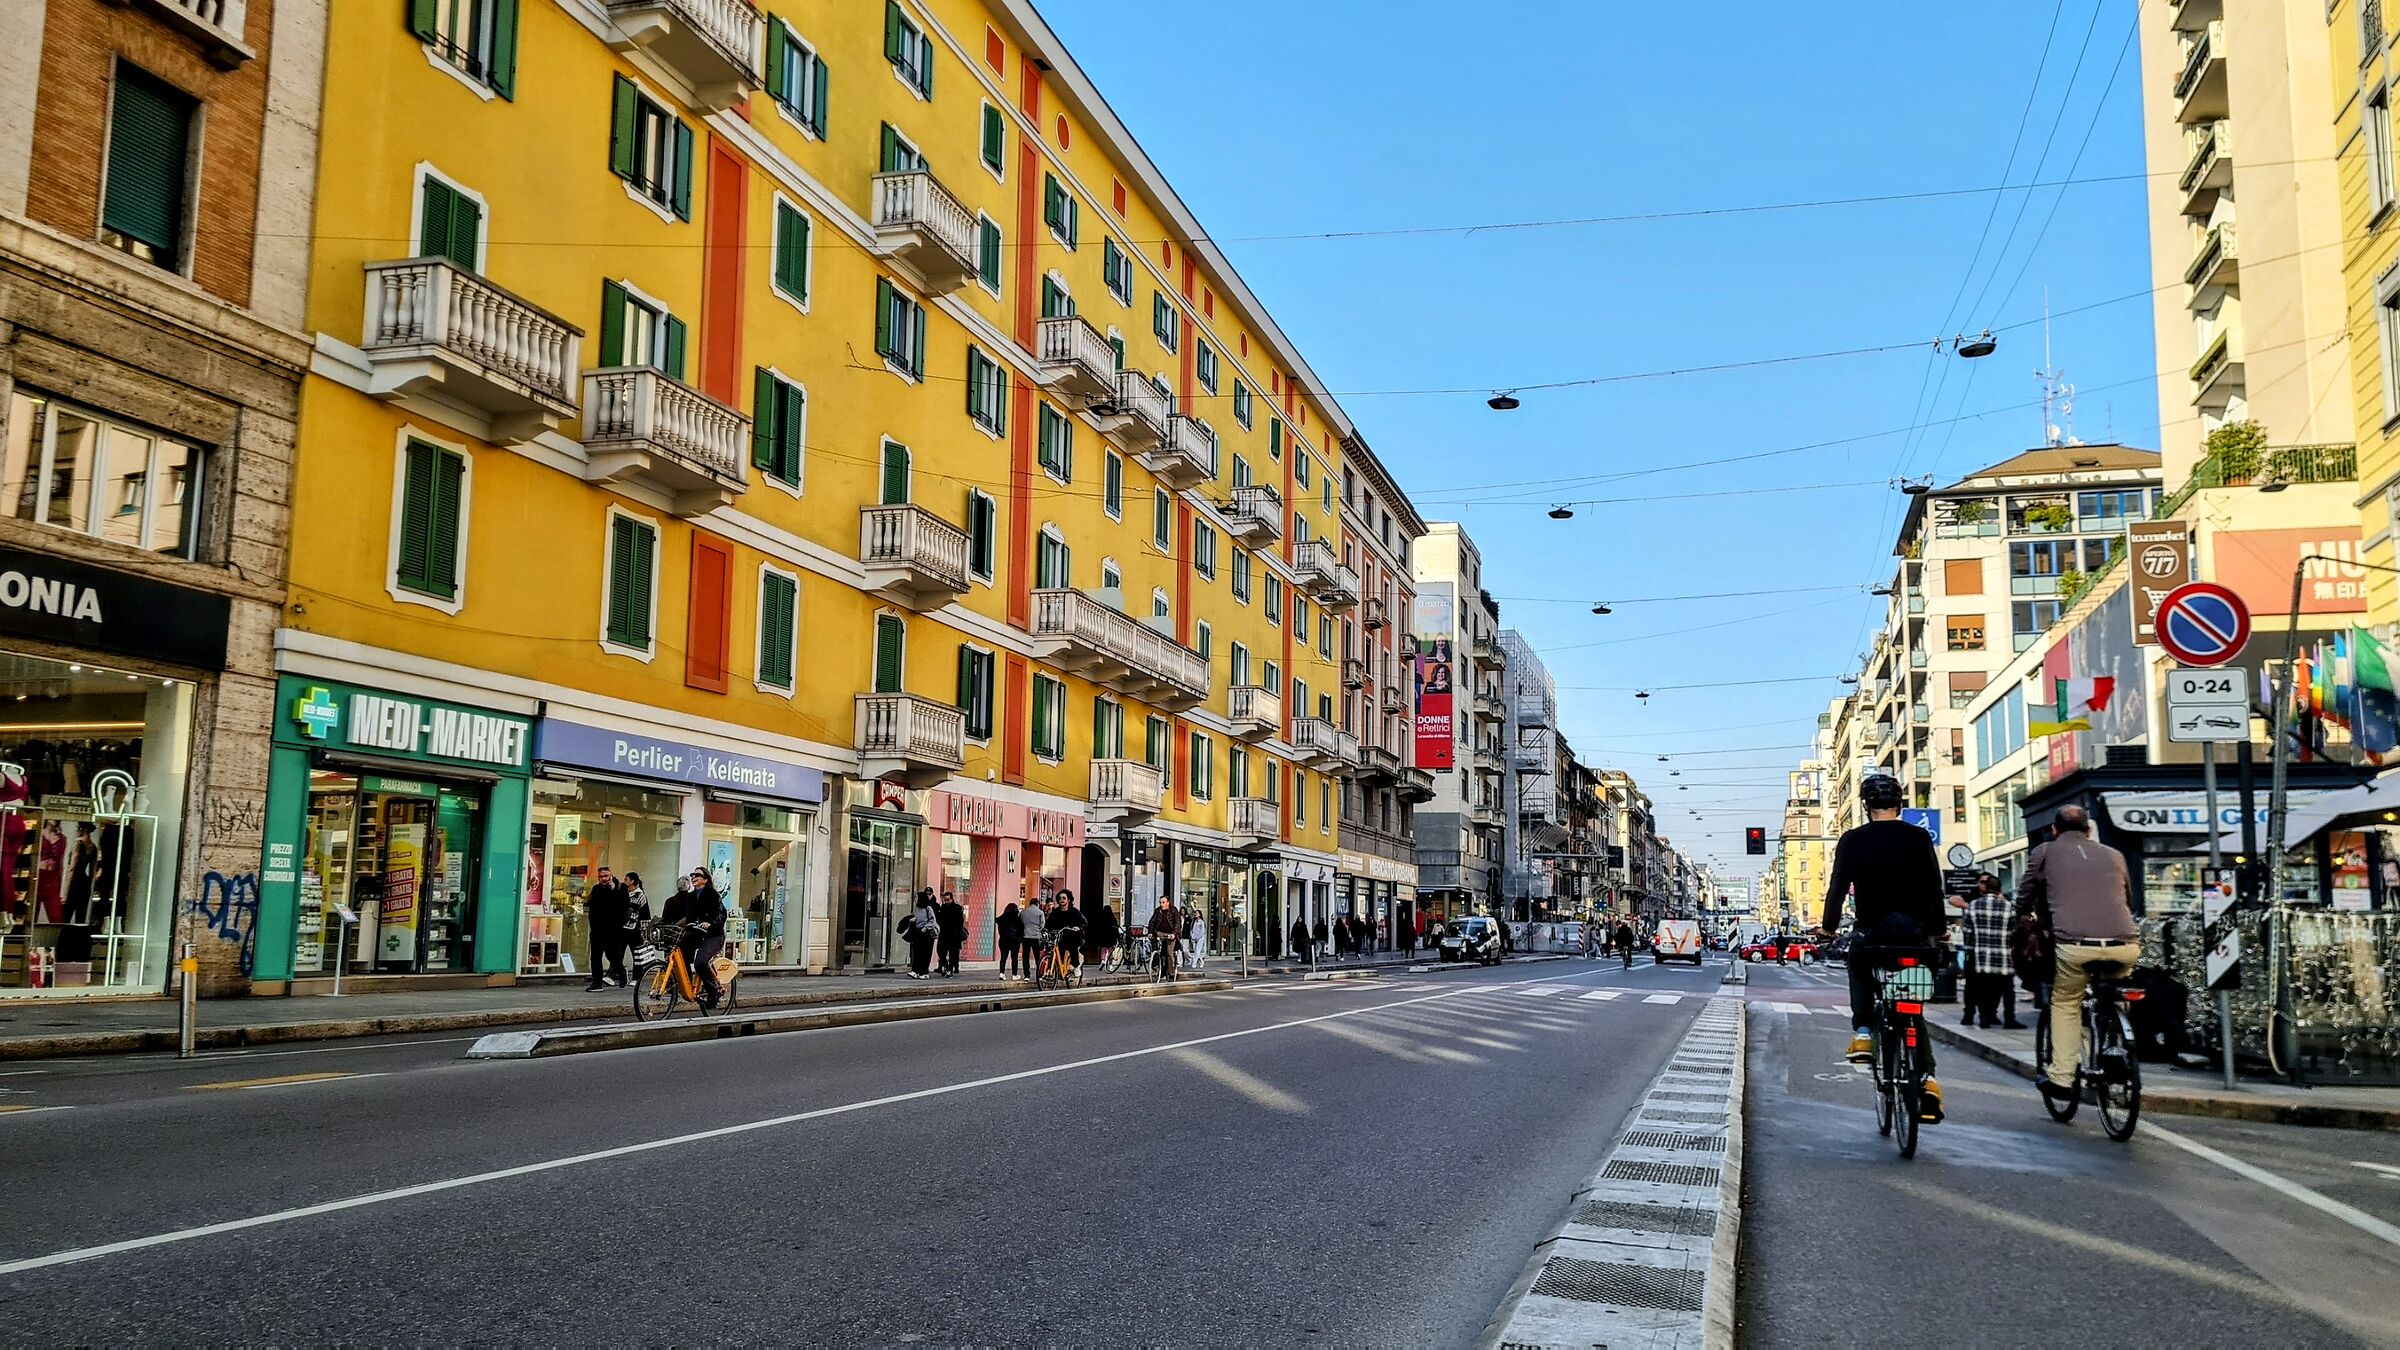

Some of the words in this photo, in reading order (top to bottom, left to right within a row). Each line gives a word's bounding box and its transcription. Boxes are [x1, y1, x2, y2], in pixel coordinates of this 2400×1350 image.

[2183, 679, 2232, 694] 0-24
[1417, 715, 1450, 724] DONNE
[347, 694, 528, 766] MEDI-MARKET
[614, 739, 683, 773] Perlier
[707, 756, 776, 788] Kelémata
[881, 782, 905, 803] CAMPER
[2124, 809, 2169, 826] QN
